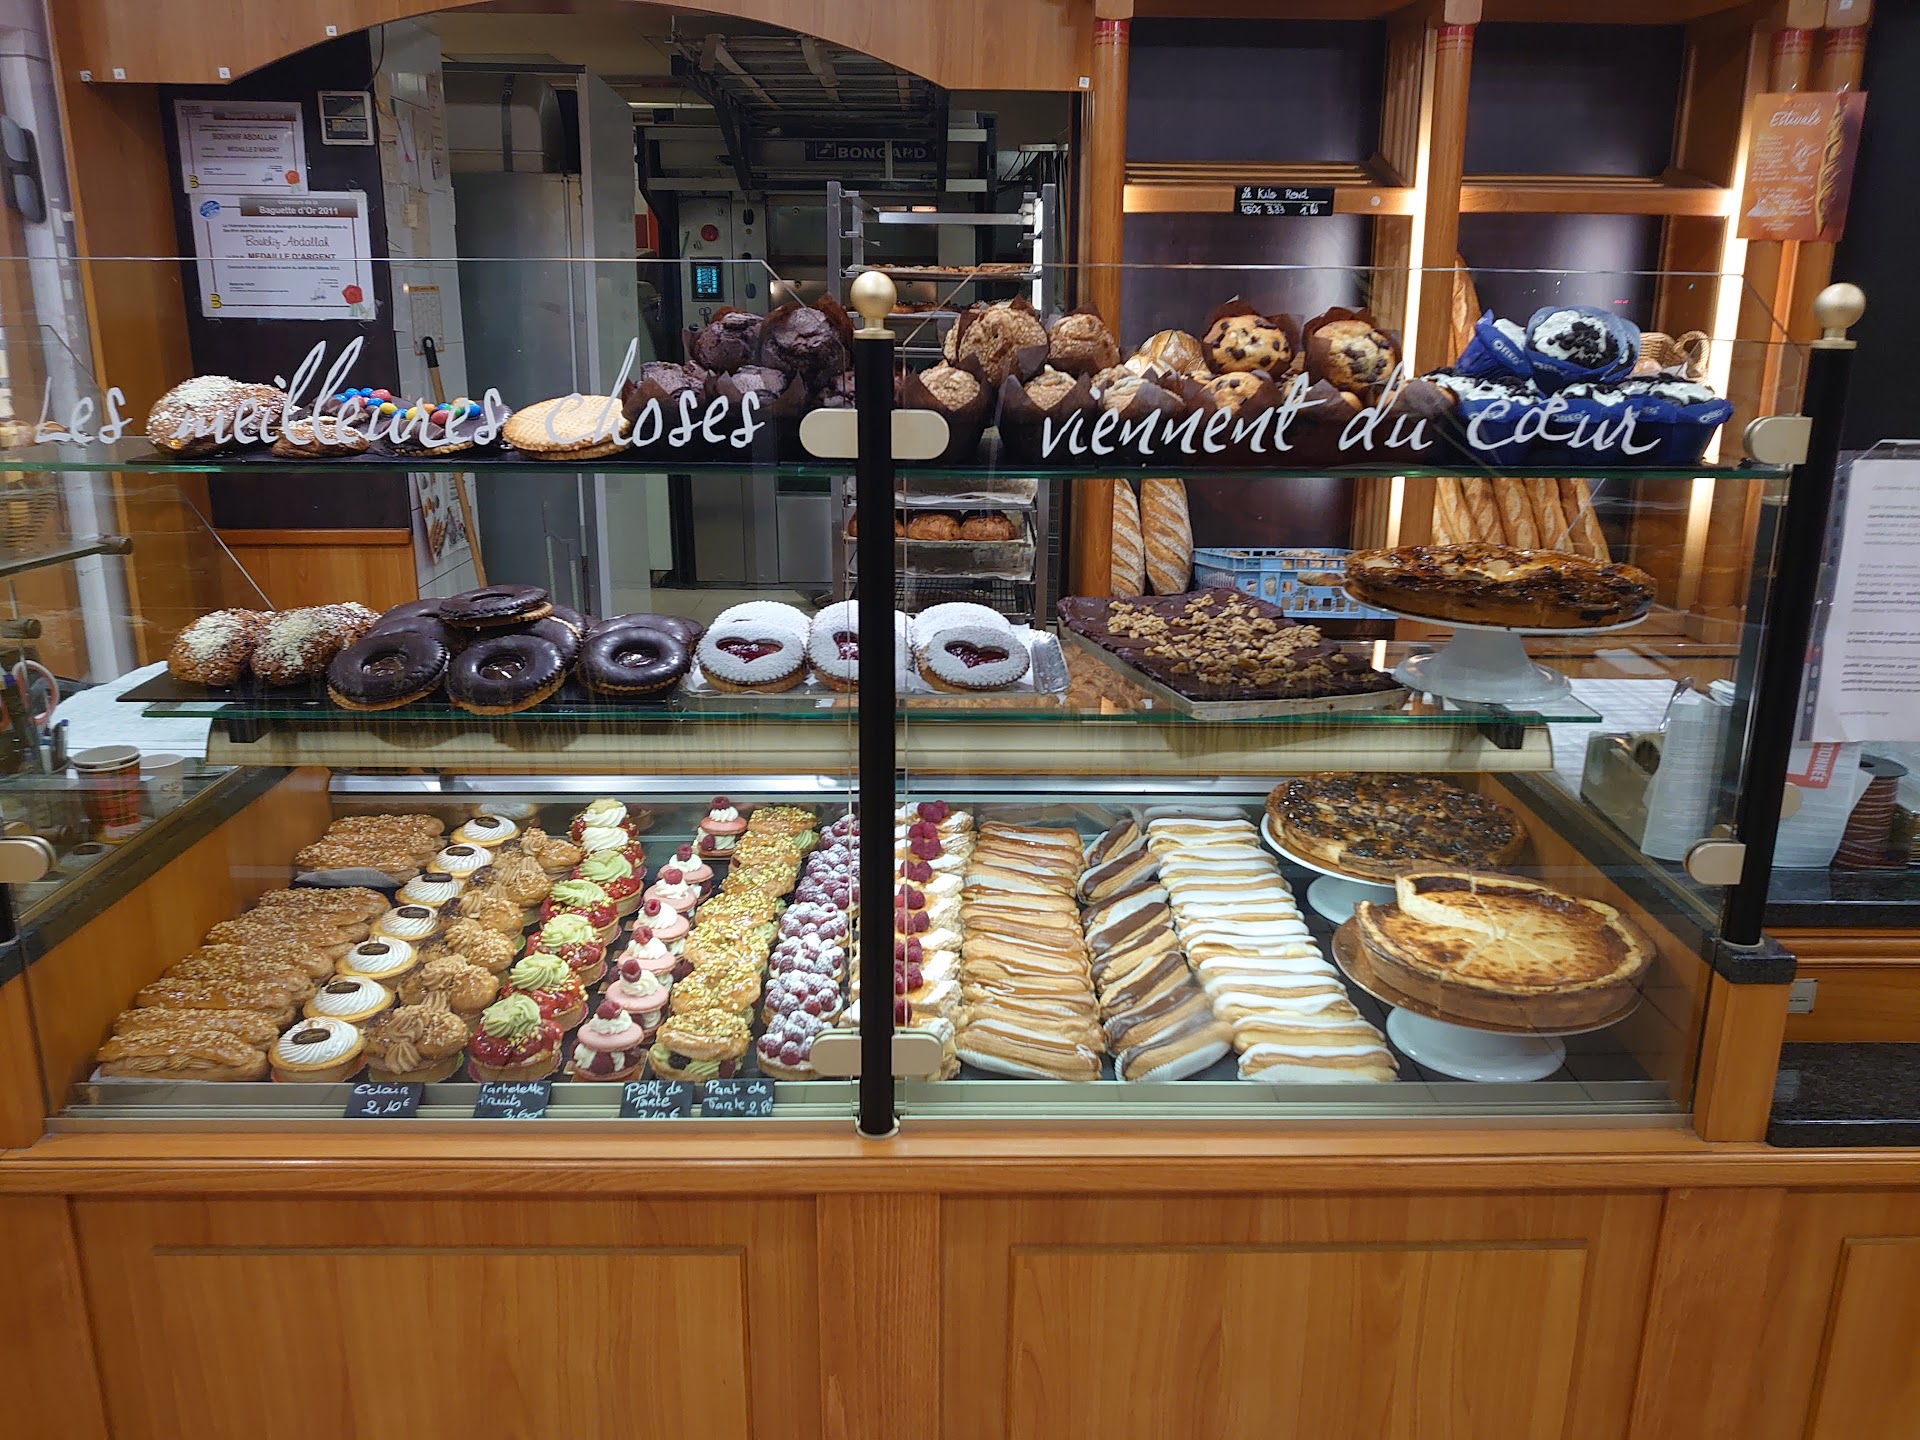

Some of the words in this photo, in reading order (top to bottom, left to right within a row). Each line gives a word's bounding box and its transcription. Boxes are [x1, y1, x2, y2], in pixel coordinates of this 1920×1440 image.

[838, 146, 926, 159] BONGARD
[259, 205, 296, 216] Baguette
[298, 206, 316, 215] d'Or
[318, 206, 339, 215] 2011
[34, 376, 133, 445] Les
[169, 335, 511, 448] meilleures
[544, 336, 766, 449] choses
[1042, 371, 1328, 459] viennent
[1338, 360, 1433, 452] du
[354, 1083, 409, 1095] Eclair
[482, 1082, 545, 1095] Tartelette
[665, 1080, 684, 1096] de
[705, 1079, 741, 1096] Part
[747, 1081, 767, 1095] de
[631, 1093, 672, 1109] Tarte
